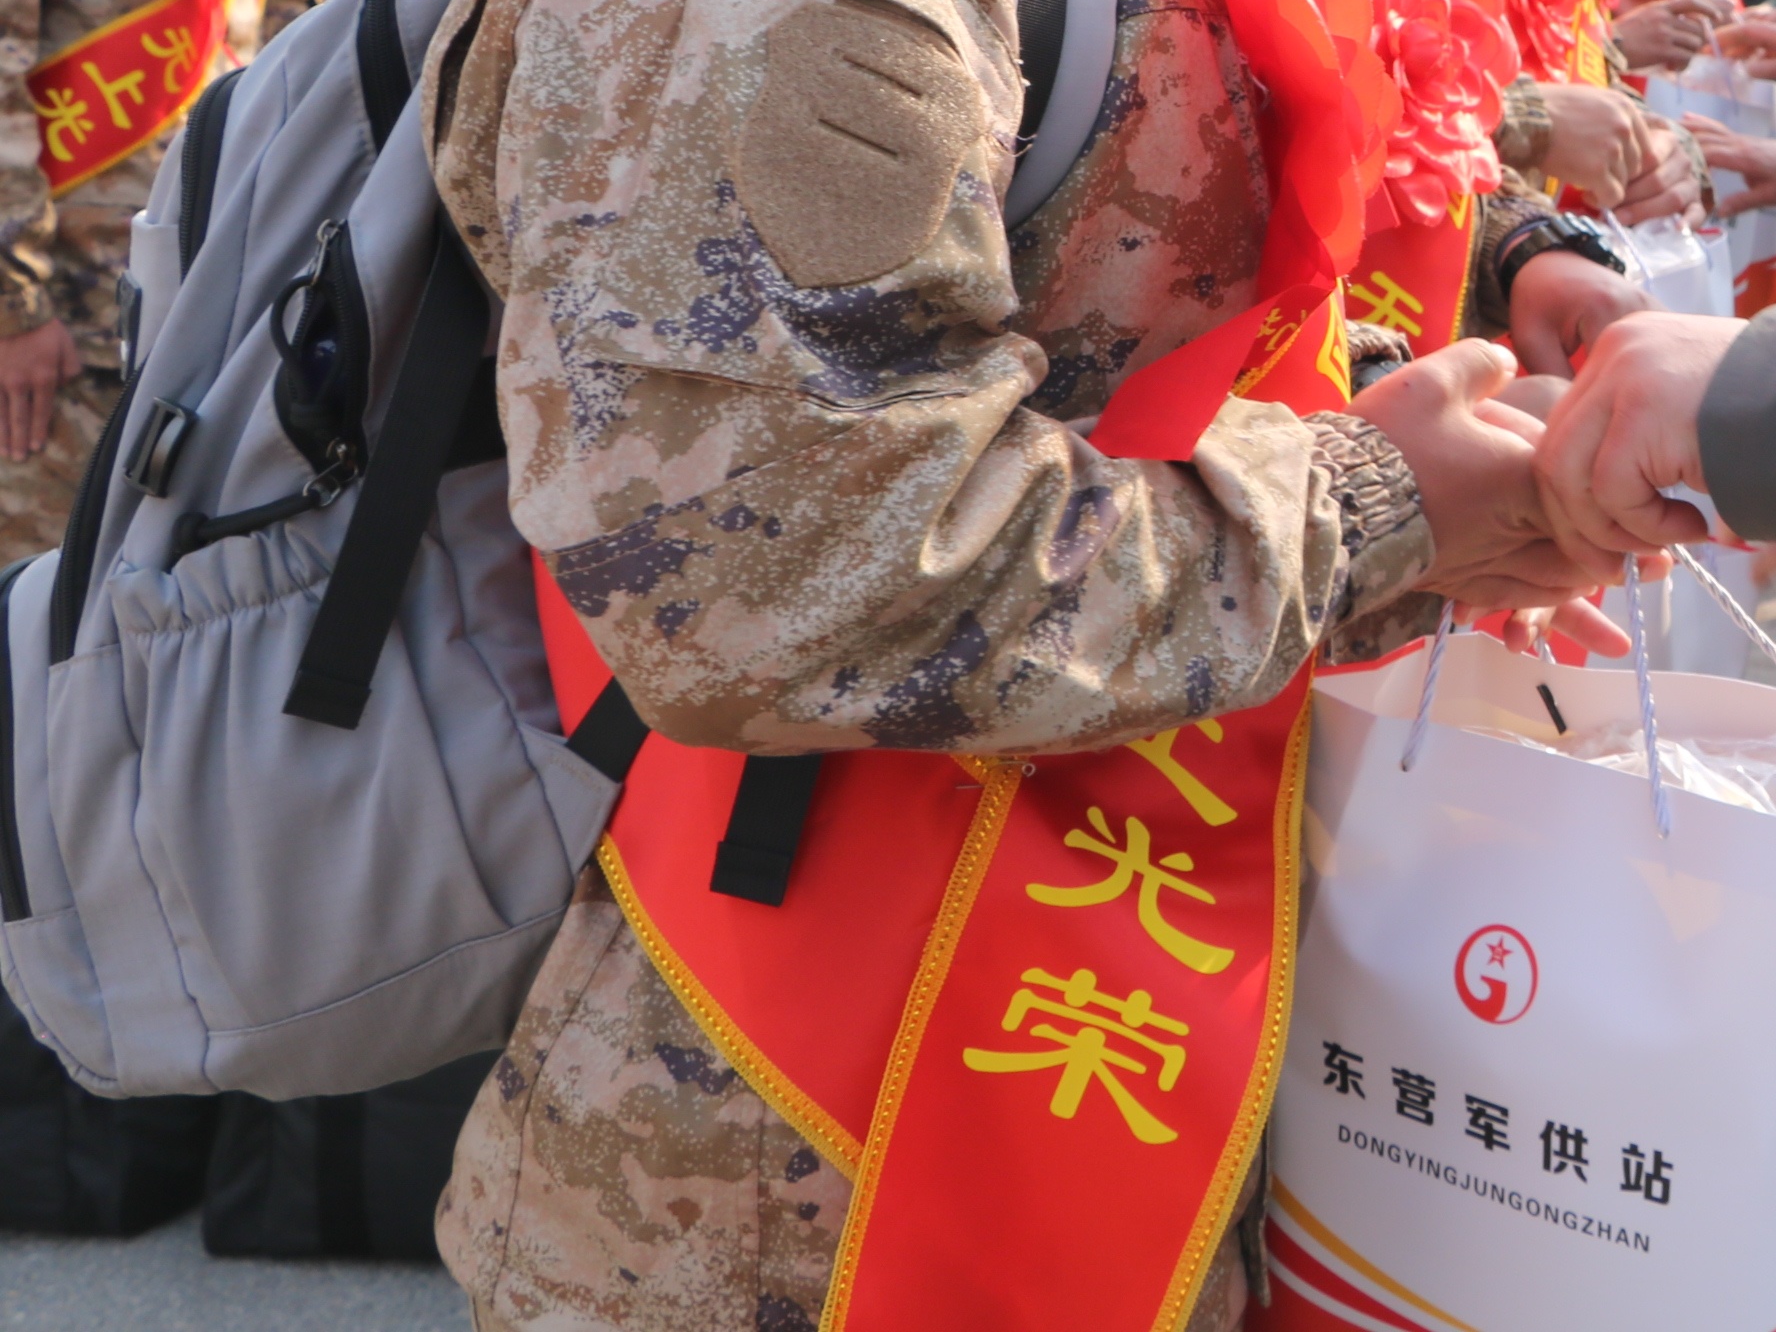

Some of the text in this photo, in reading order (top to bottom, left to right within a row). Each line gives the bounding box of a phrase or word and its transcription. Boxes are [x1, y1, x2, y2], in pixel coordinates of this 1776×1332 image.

[1322, 1040, 1674, 1206] 东营军供站
[1338, 1124, 1651, 1254] DONGYINGJUNGONGZHAN
